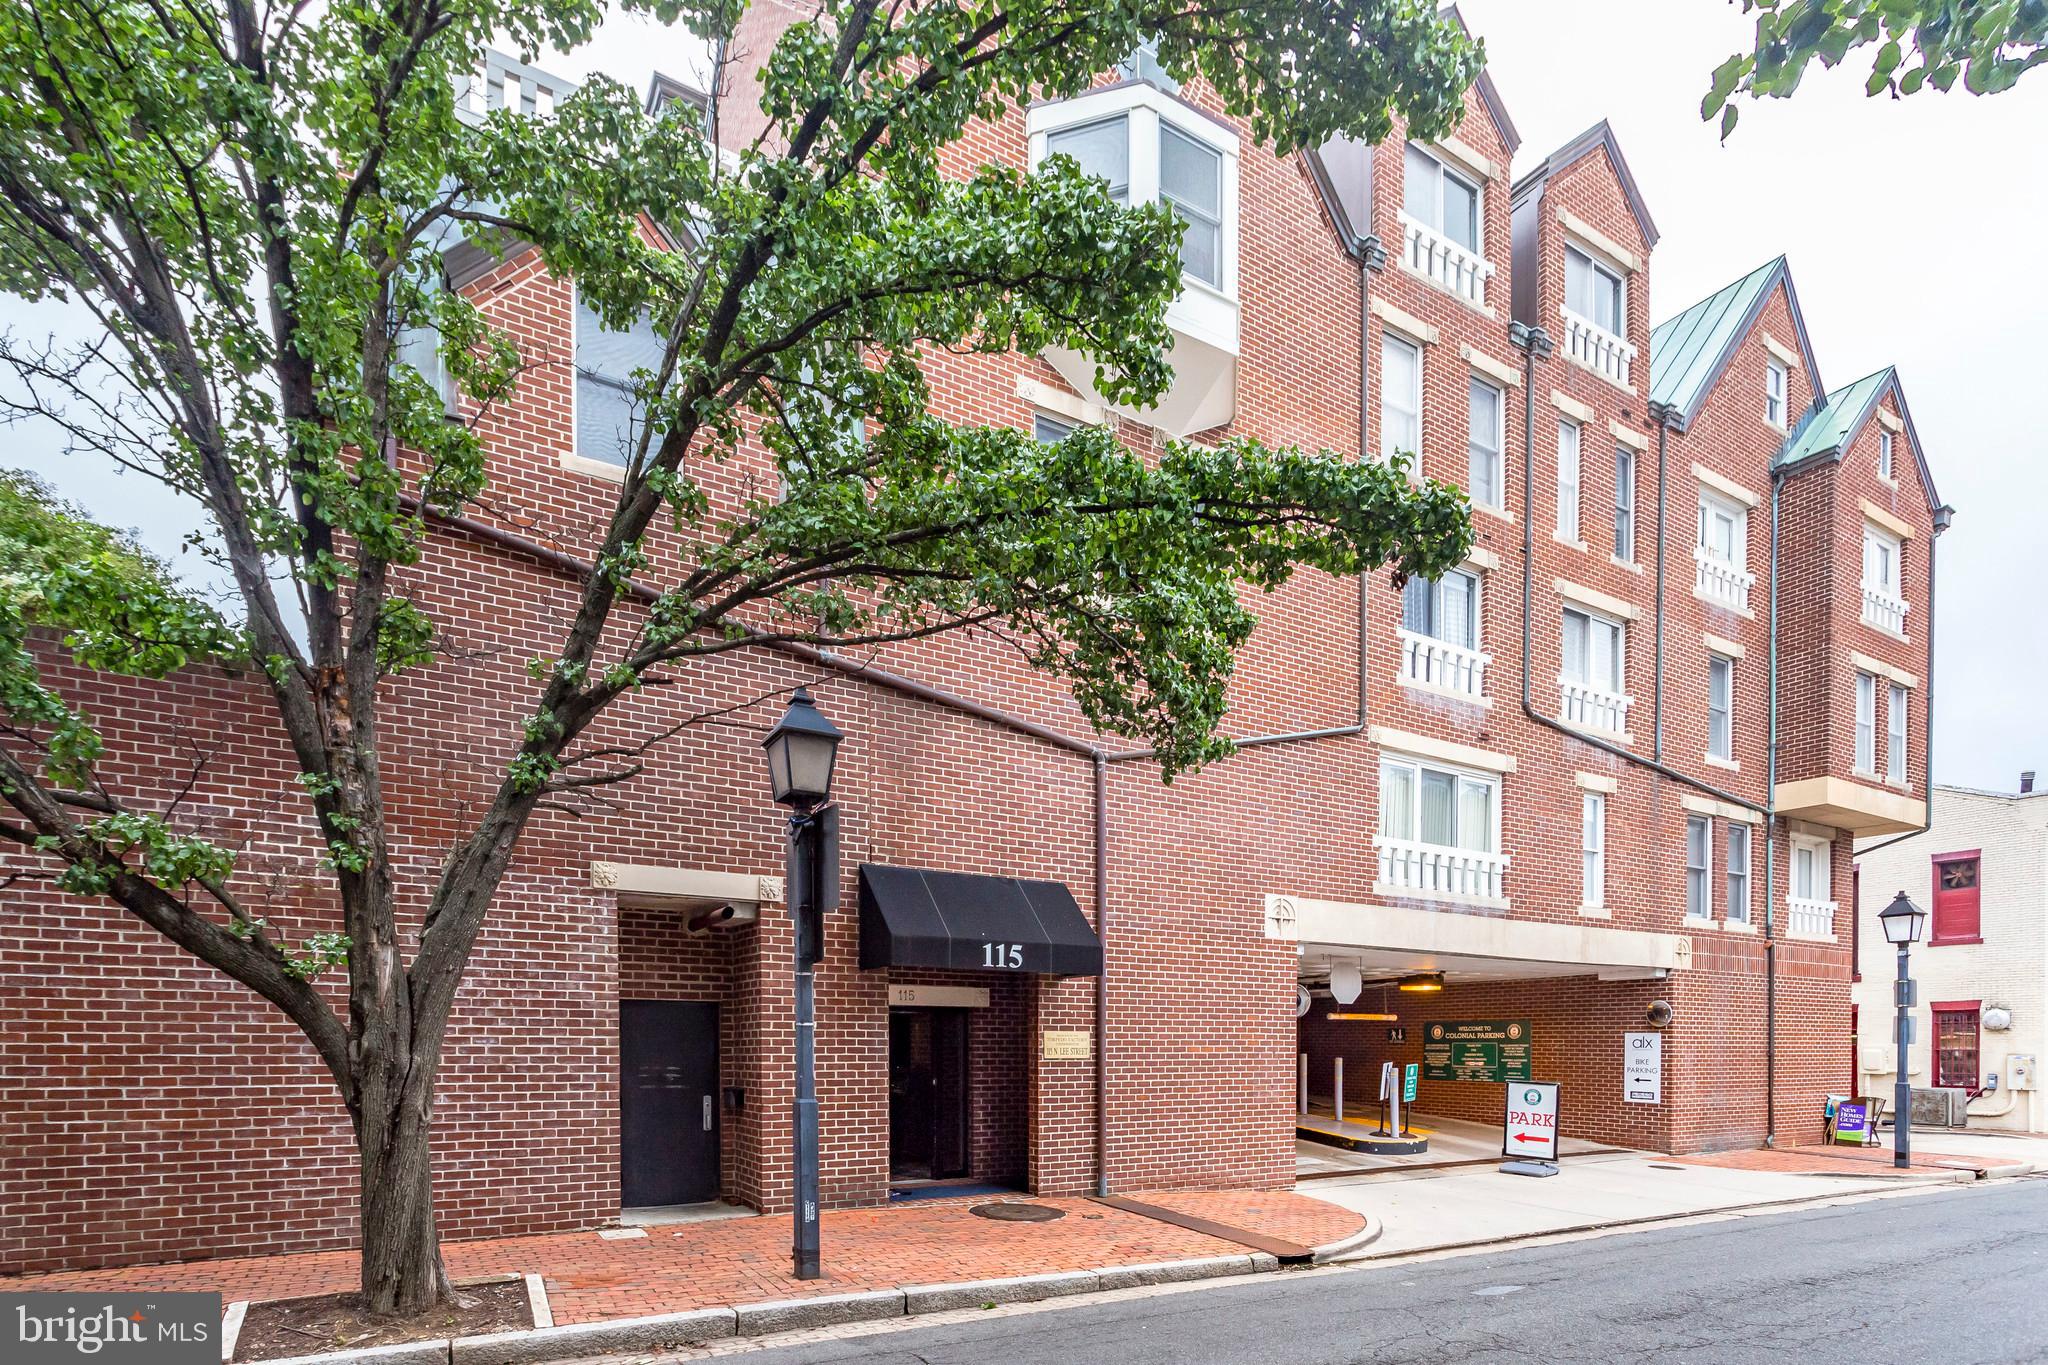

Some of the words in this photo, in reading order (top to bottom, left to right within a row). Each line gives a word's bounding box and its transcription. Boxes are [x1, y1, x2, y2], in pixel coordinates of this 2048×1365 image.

[982, 943, 1023, 968] 115
[898, 989, 915, 1001] 115
[1632, 1036, 1653, 1049] alx
[1635, 1058, 1649, 1066] BIKE
[1626, 1066, 1658, 1074] PARKING
[1509, 1111, 1554, 1128] PARK
